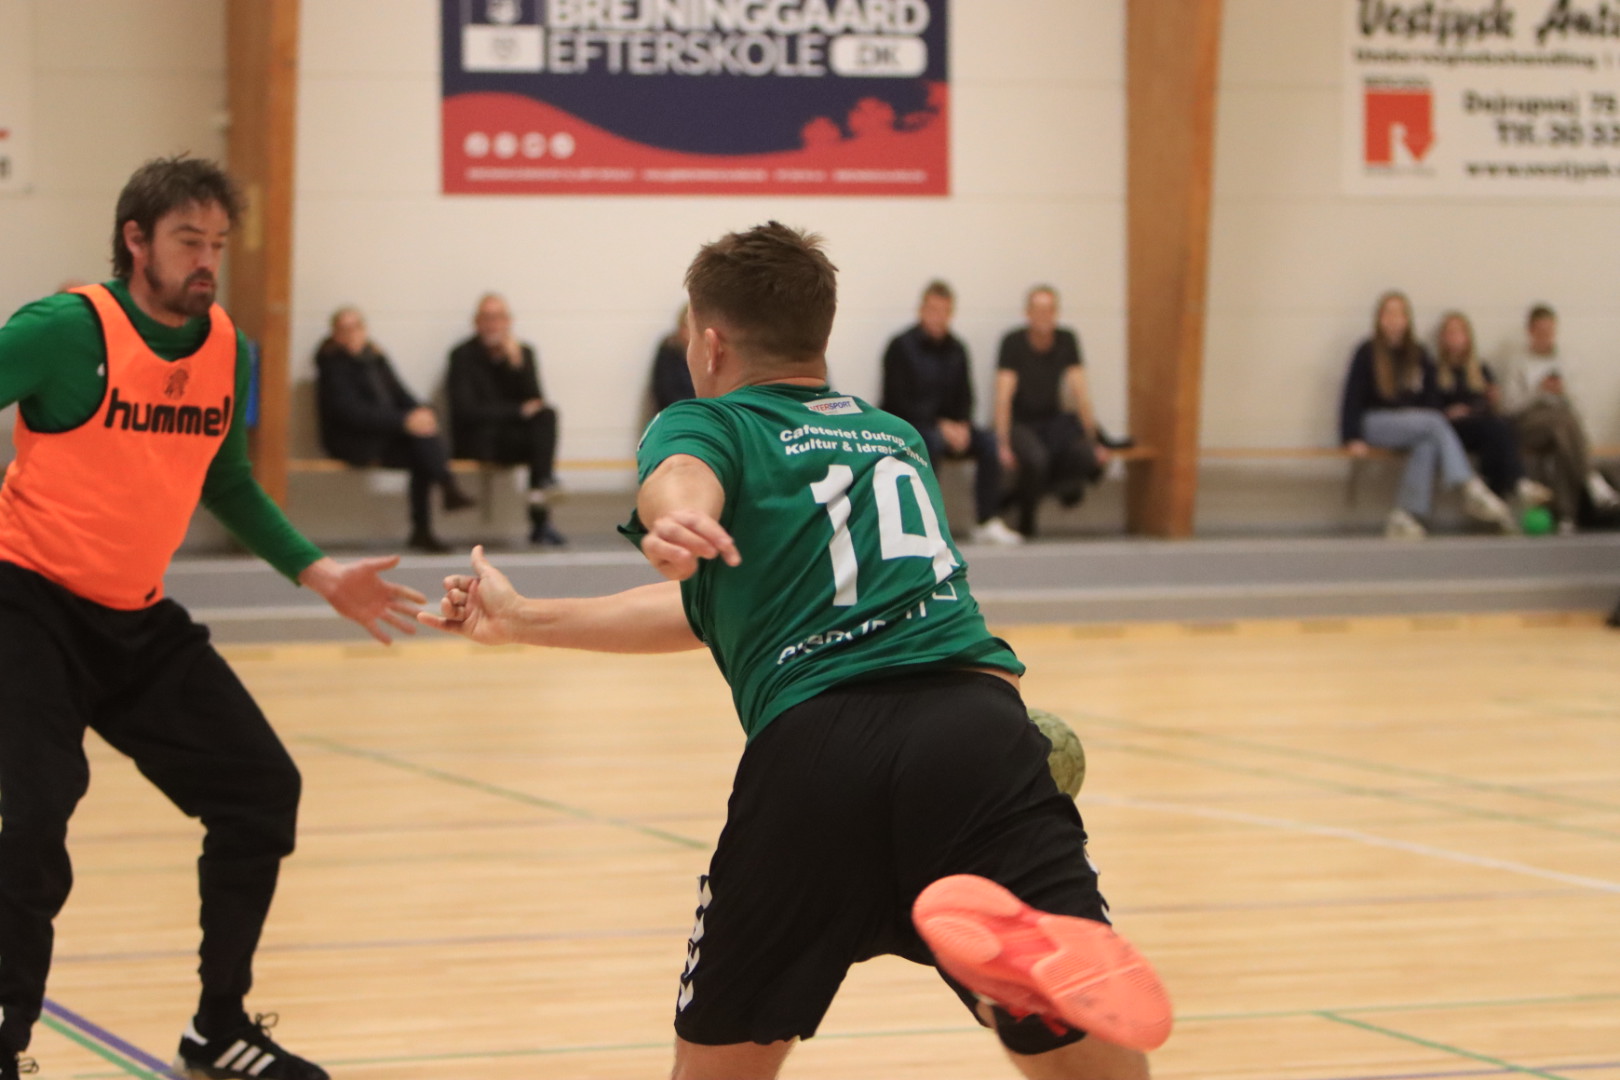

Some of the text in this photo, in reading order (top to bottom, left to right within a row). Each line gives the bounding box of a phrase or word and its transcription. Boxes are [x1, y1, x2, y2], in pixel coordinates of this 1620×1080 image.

[548, 0, 930, 35] BREJNINGGAARD
[548, 34, 828, 76] EFTERSKOLE
[103, 387, 231, 437] hummel
[779, 424, 905, 447] Cafeteriet Outrup
[784, 438, 838, 456] Kultur
[842, 440, 853, 452] &
[809, 455, 960, 606] 14
